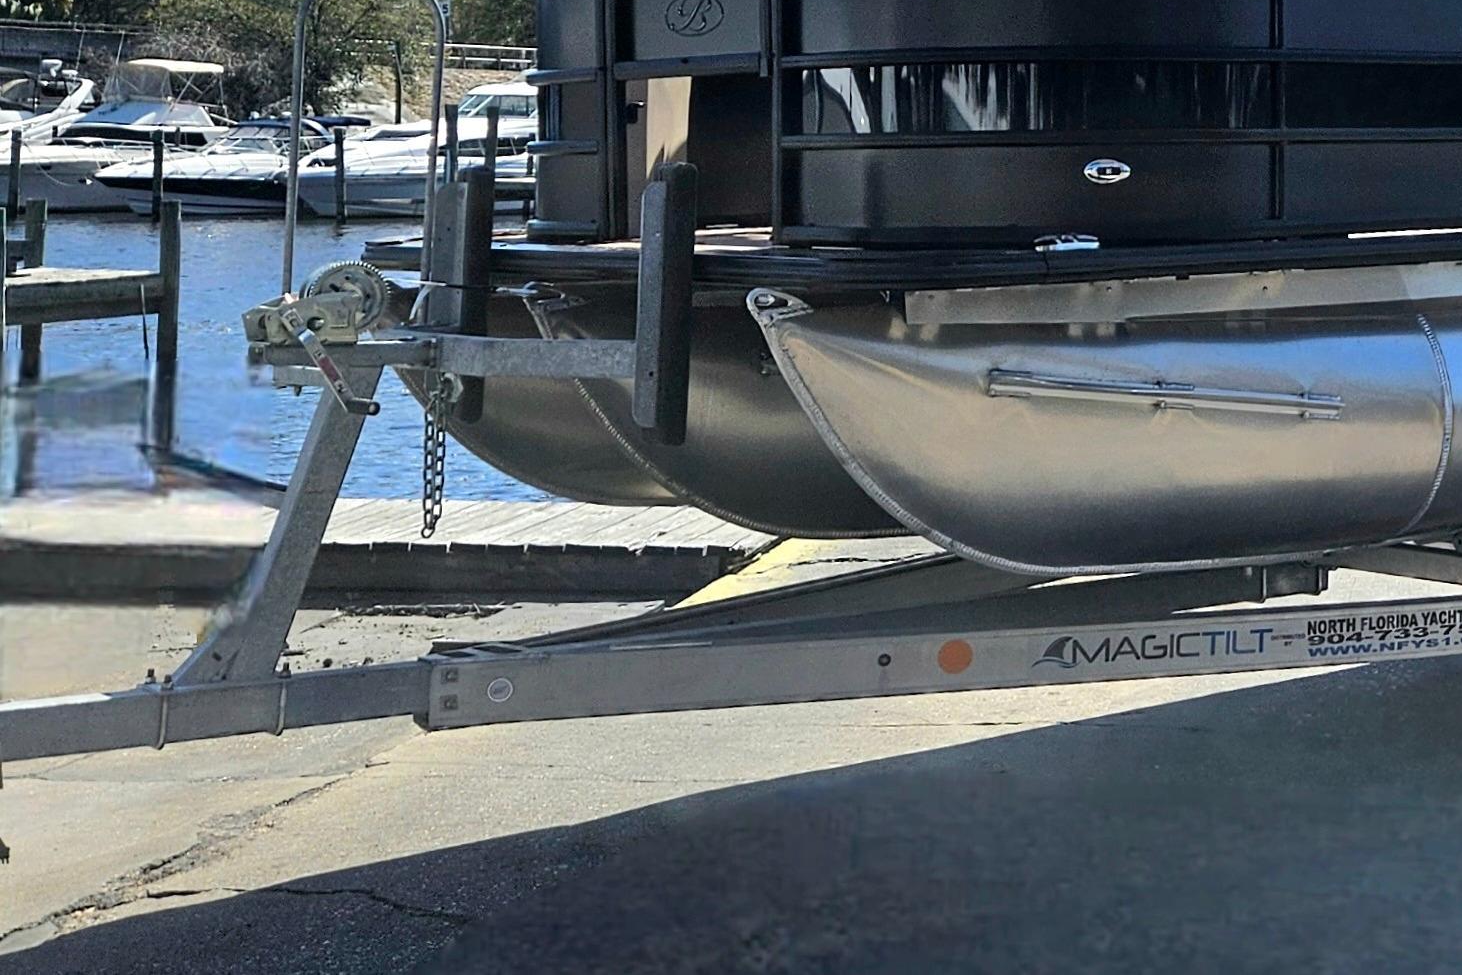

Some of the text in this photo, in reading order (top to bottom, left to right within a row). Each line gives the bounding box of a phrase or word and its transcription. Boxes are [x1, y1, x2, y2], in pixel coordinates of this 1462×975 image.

[1307, 617, 1356, 636] NORTH
[1360, 613, 1419, 632] FLORIDA
[1071, 628, 1274, 664] MAGICTILT
